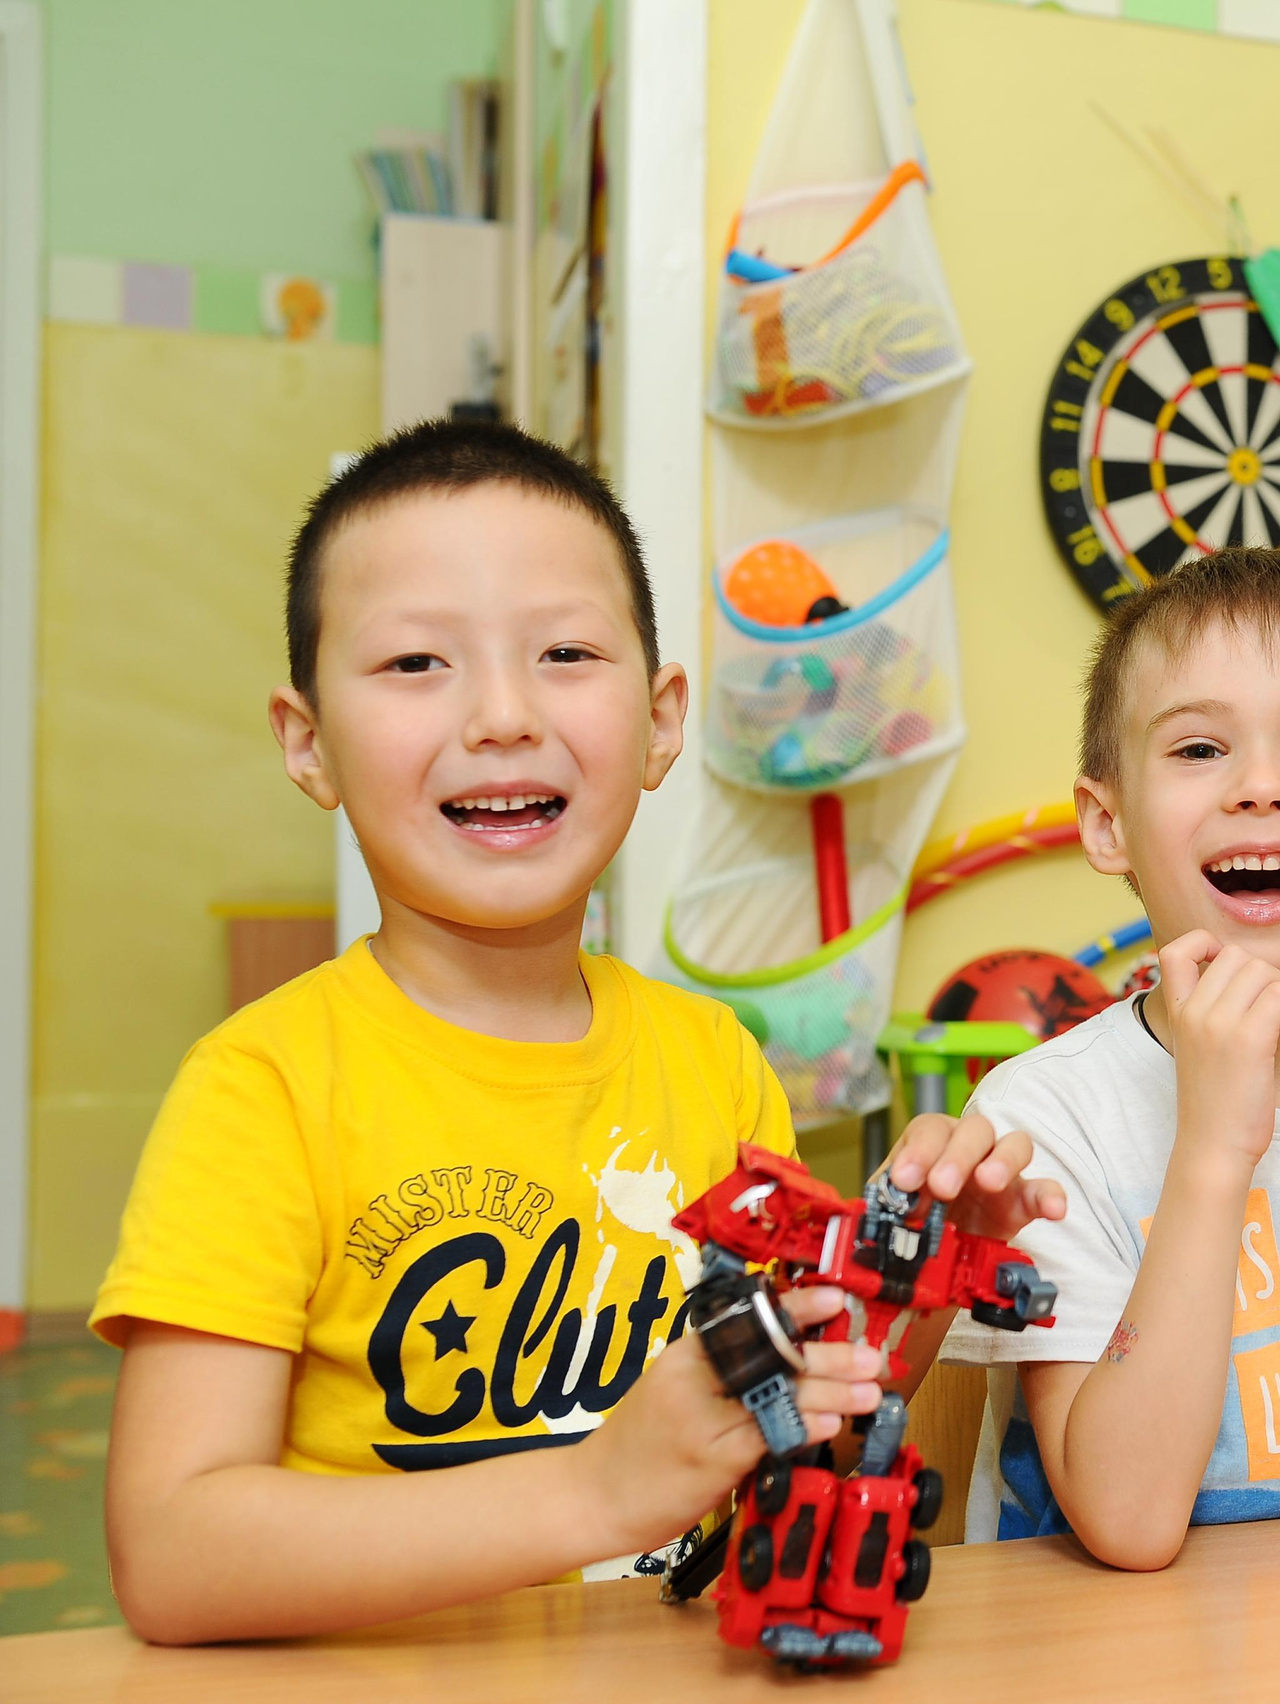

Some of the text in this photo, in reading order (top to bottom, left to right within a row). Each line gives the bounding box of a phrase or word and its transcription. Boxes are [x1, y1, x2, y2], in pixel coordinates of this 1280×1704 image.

[1146, 265, 1186, 303] 12
[1207, 257, 1232, 290] 5
[1104, 299, 1135, 332] 9
[1065, 339, 1105, 381] 14
[1051, 400, 1085, 432] 11
[345, 1166, 554, 1279] MISTER
